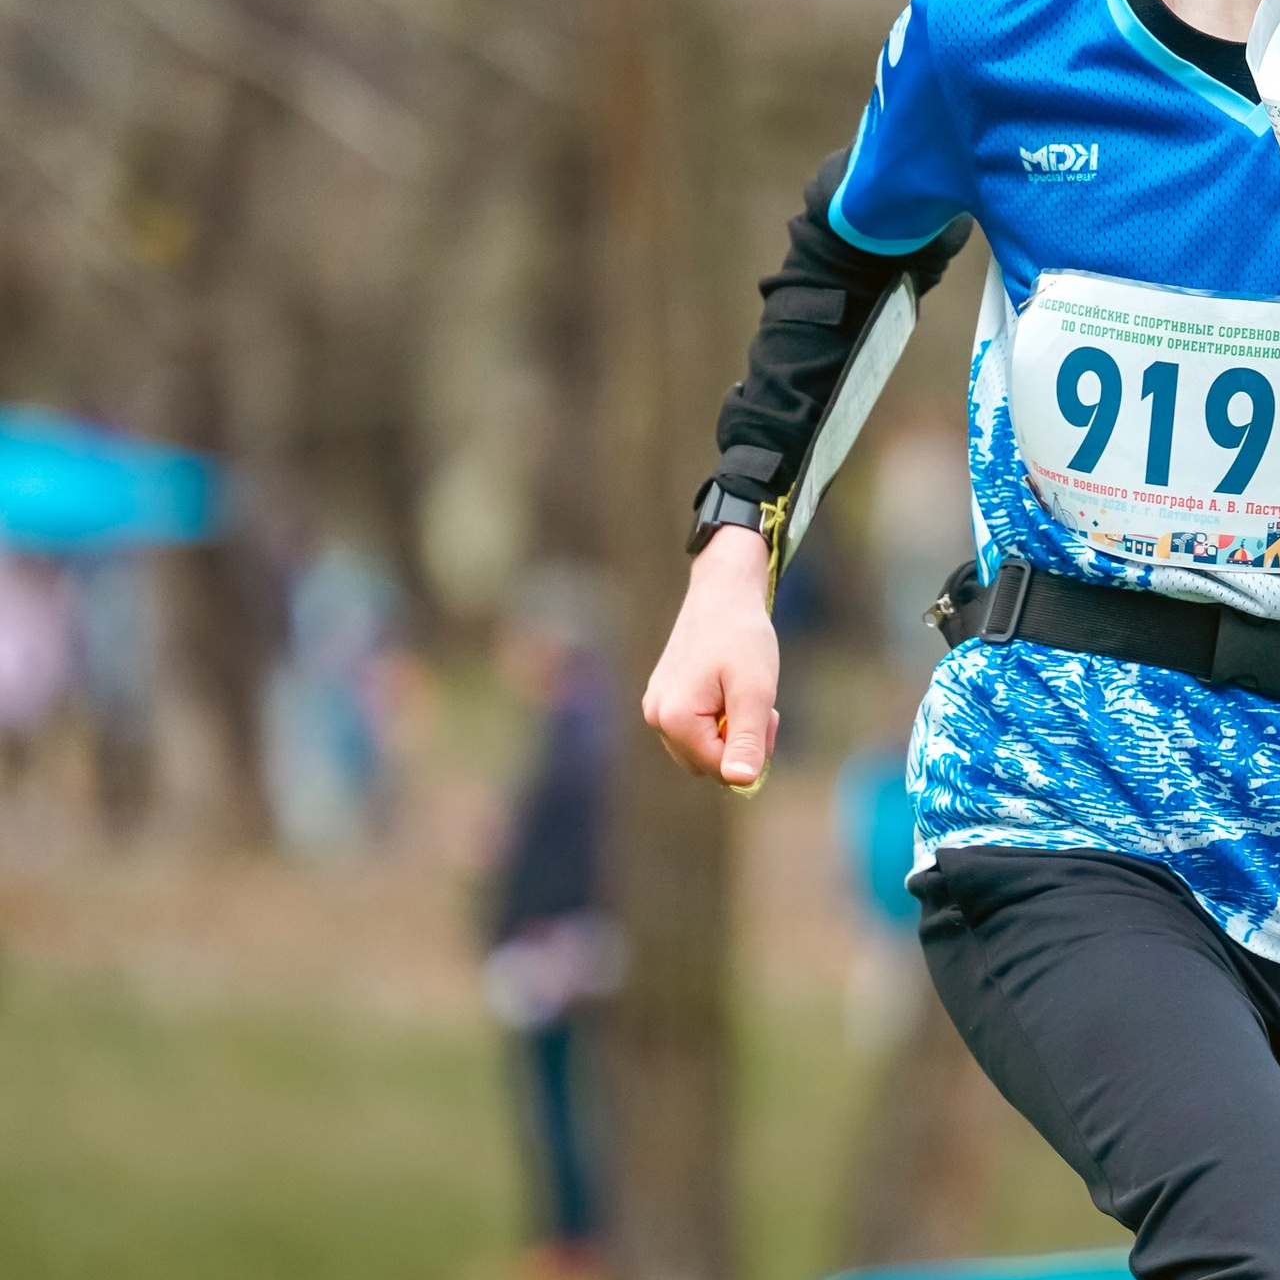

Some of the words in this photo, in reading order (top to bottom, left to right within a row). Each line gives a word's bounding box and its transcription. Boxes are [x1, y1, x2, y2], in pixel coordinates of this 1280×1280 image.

[1066, 173, 1097, 182] wear
[1038, 298, 1130, 324] ВСЕРОССИЙСКИЕ
[1134, 315, 1214, 336] СПОРТИВНЫЕ
[1061, 319, 1076, 332] ПО
[1080, 323, 1163, 347] СПОРТИВНОМУ
[1056, 346, 1276, 495] 919
[1032, 461, 1069, 485] Памяти
[1073, 478, 1128, 499] военного
[1133, 491, 1204, 512] топографа
[1208, 499, 1221, 512] А.
[1227, 501, 1239, 513] В.
